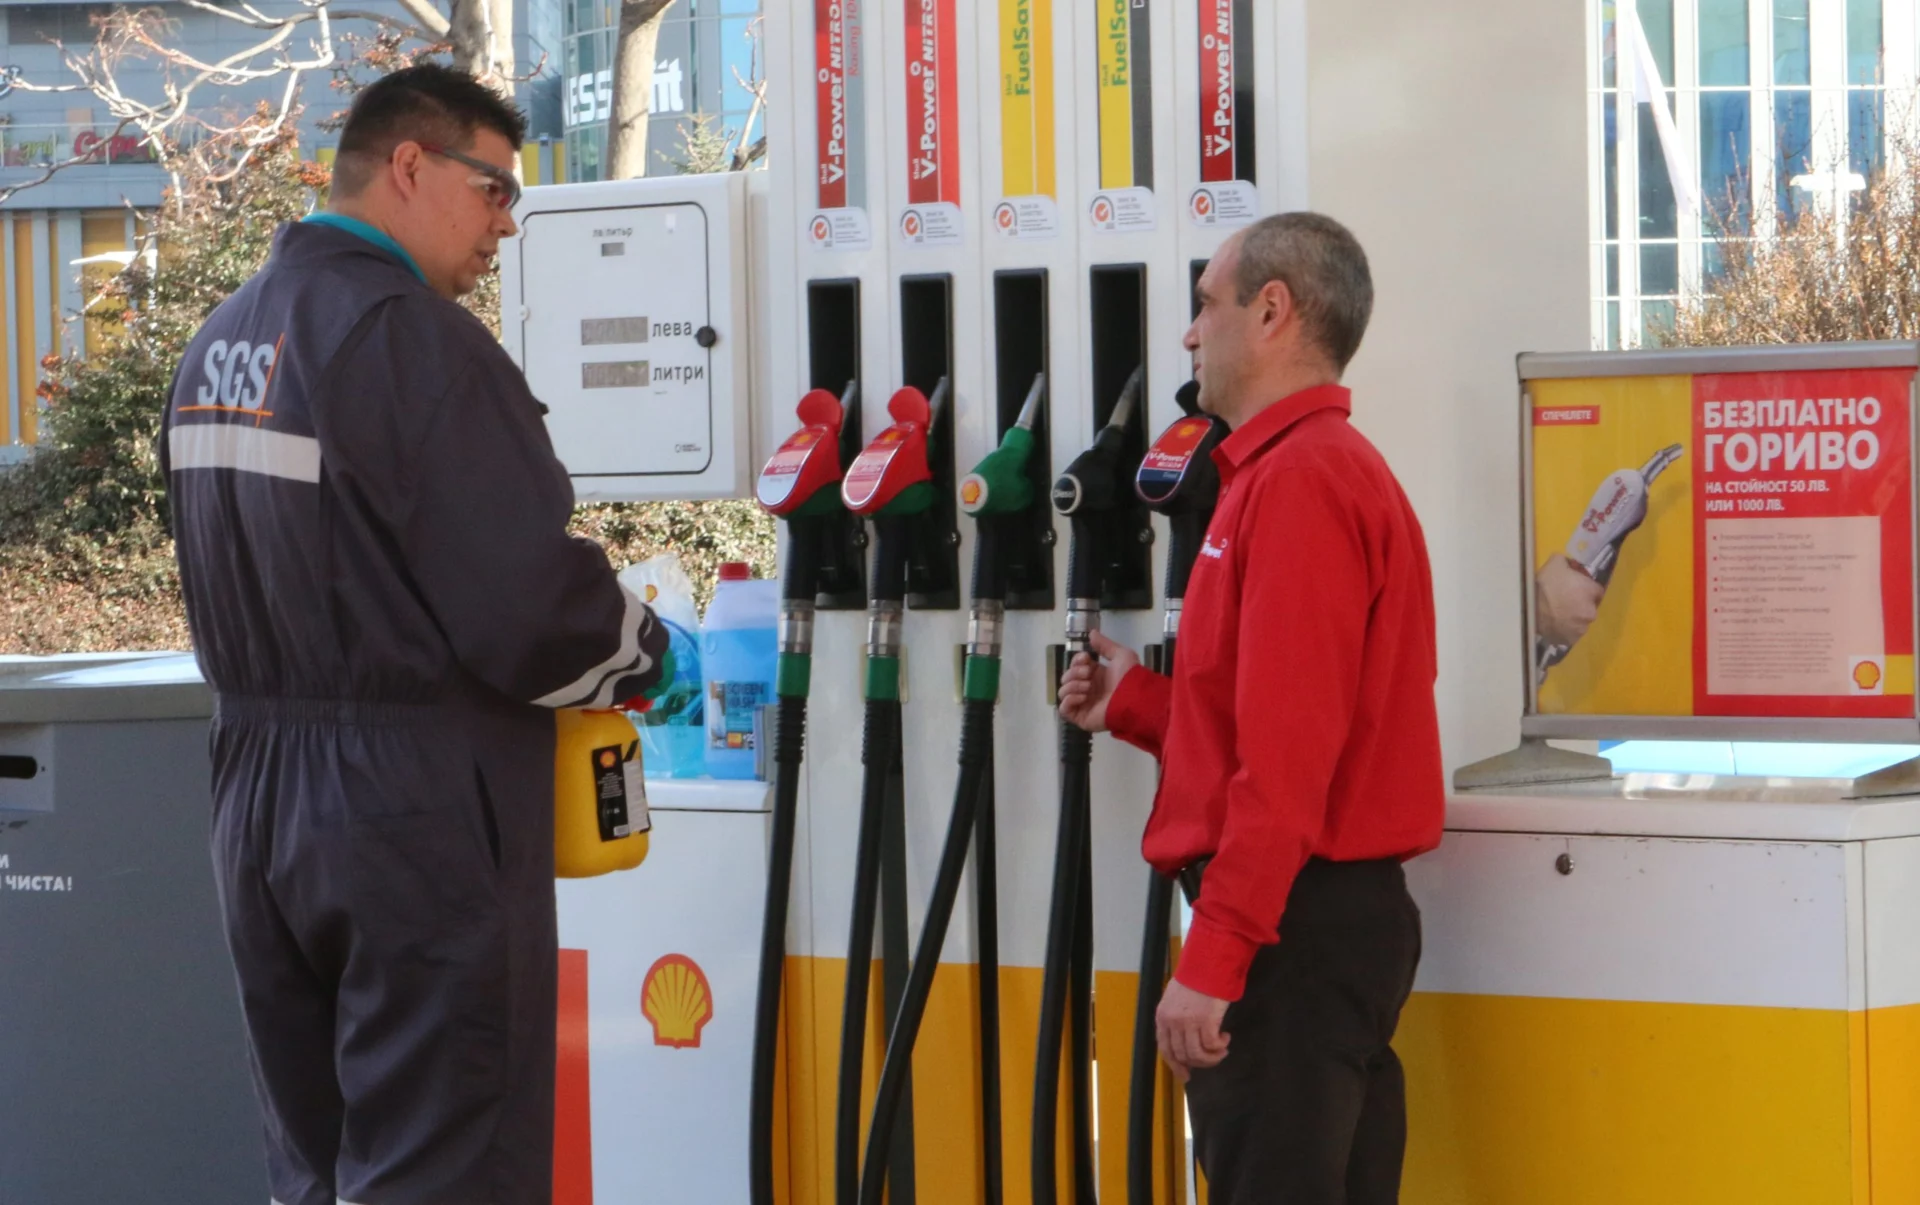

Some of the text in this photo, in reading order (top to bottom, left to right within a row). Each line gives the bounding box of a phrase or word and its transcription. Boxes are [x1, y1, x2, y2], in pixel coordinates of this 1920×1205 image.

[847, 26, 861, 76] Racing
[1214, 39, 1231, 156] V-Power
[828, 72, 844, 184] V-Power
[920, 65, 937, 180] V-Power
[652, 321, 692, 337] лева
[197, 339, 275, 411] SGS
[653, 365, 704, 384] литри
[1542, 409, 1592, 421] СПЕЧЕЛЕТЕ
[1704, 397, 1881, 428] БЕЗПЛАТНО
[1704, 430, 1880, 472] ГОРИВО
[1705, 479, 1829, 493] НА СТОЙНОСТ 50 ЛВ.
[1706, 499, 1785, 511] ИЛИ 1000 ЛВ.
[5, 874, 72, 891] ЧИСТА!
